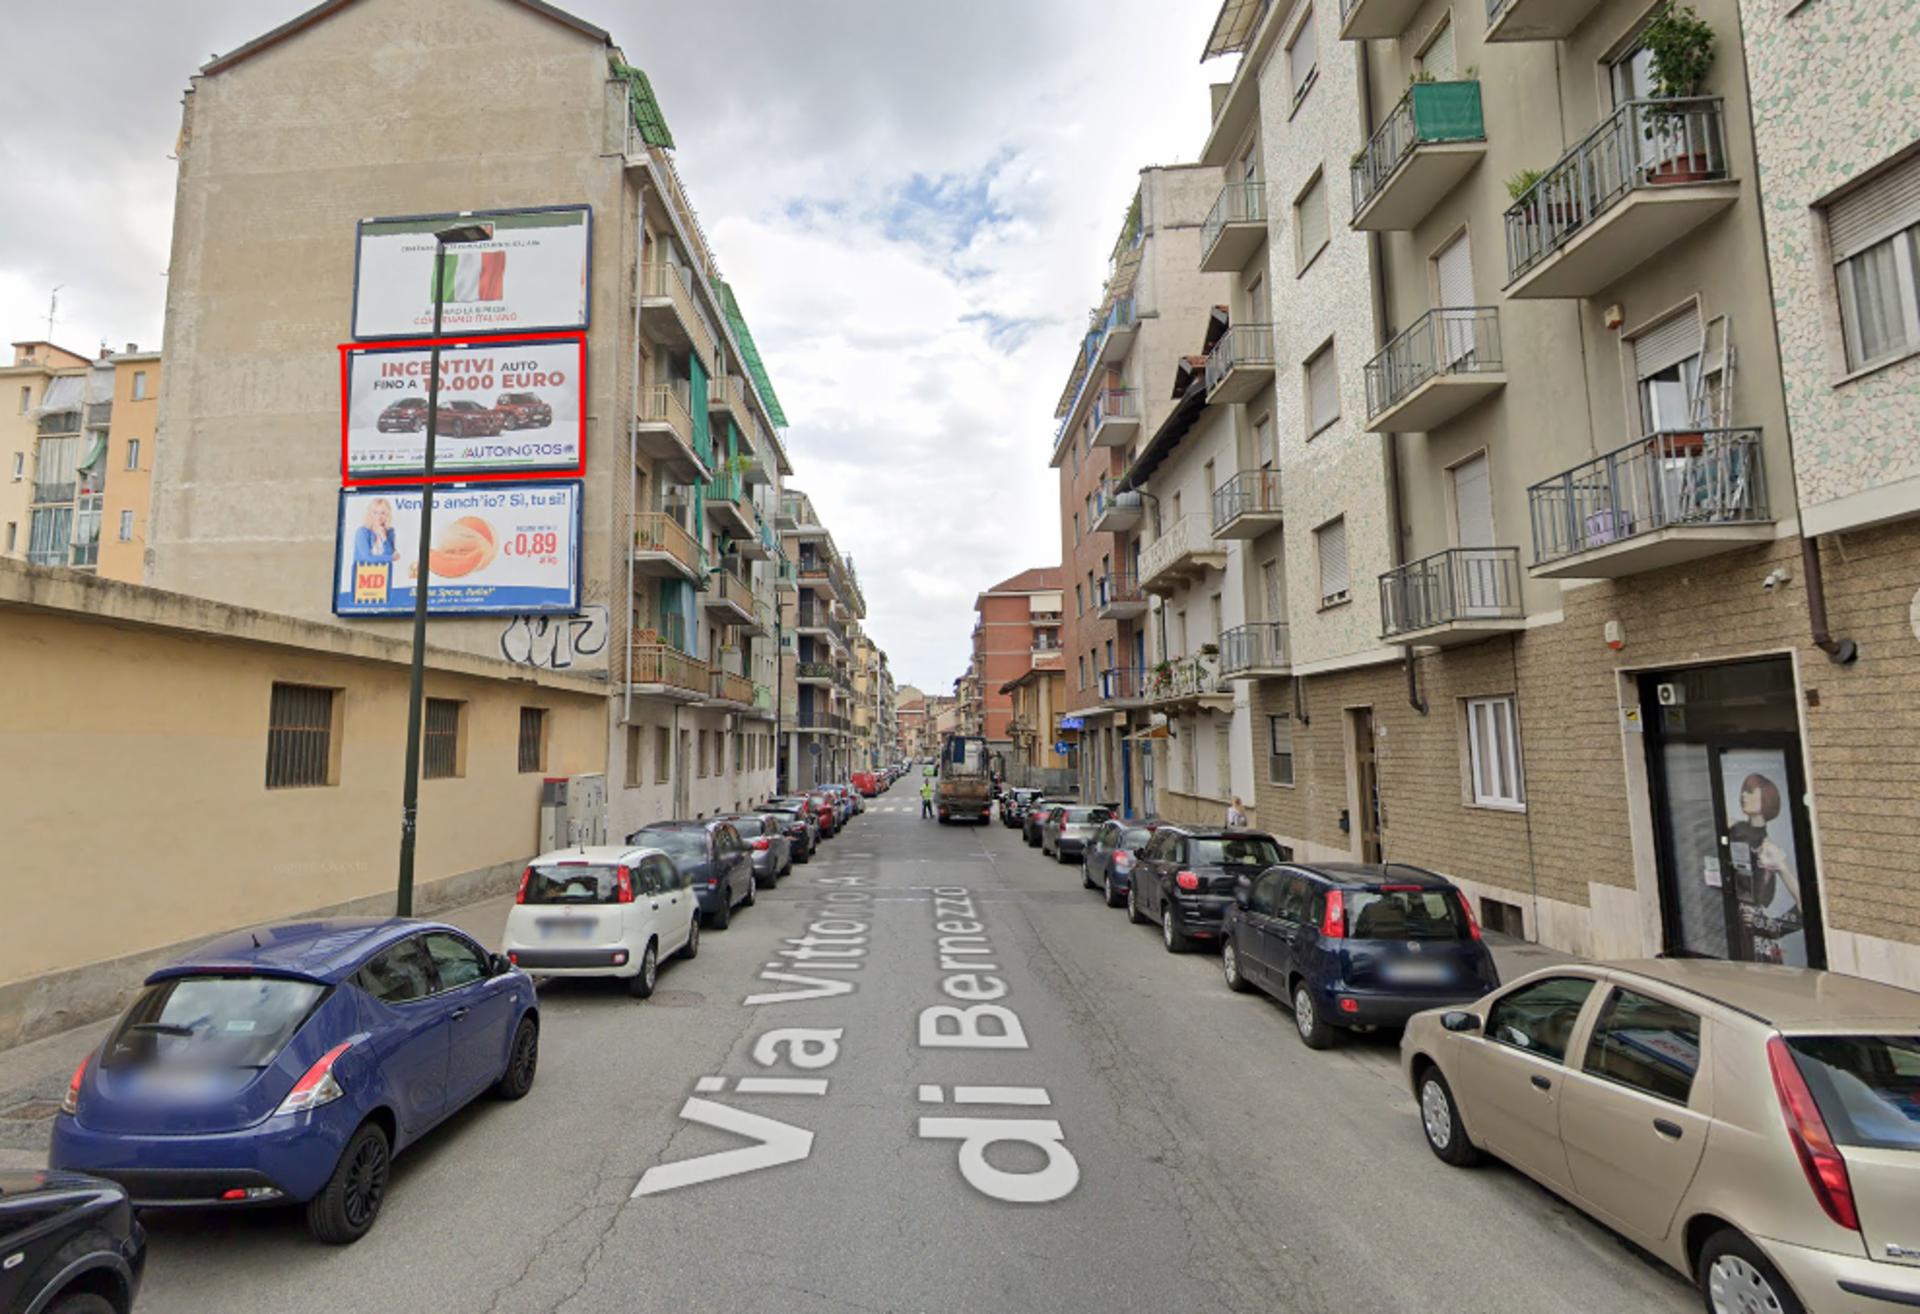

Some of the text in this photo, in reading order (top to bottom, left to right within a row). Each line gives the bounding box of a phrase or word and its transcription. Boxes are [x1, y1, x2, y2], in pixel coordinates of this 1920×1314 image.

[381, 358, 538, 377] INCENTIVI AUTO
[374, 379, 404, 390] FINO
[407, 379, 418, 389] A
[502, 371, 565, 389] EURO
[395, 498, 440, 511] Veno
[531, 494, 546, 506] tu
[358, 574, 385, 589] MD
